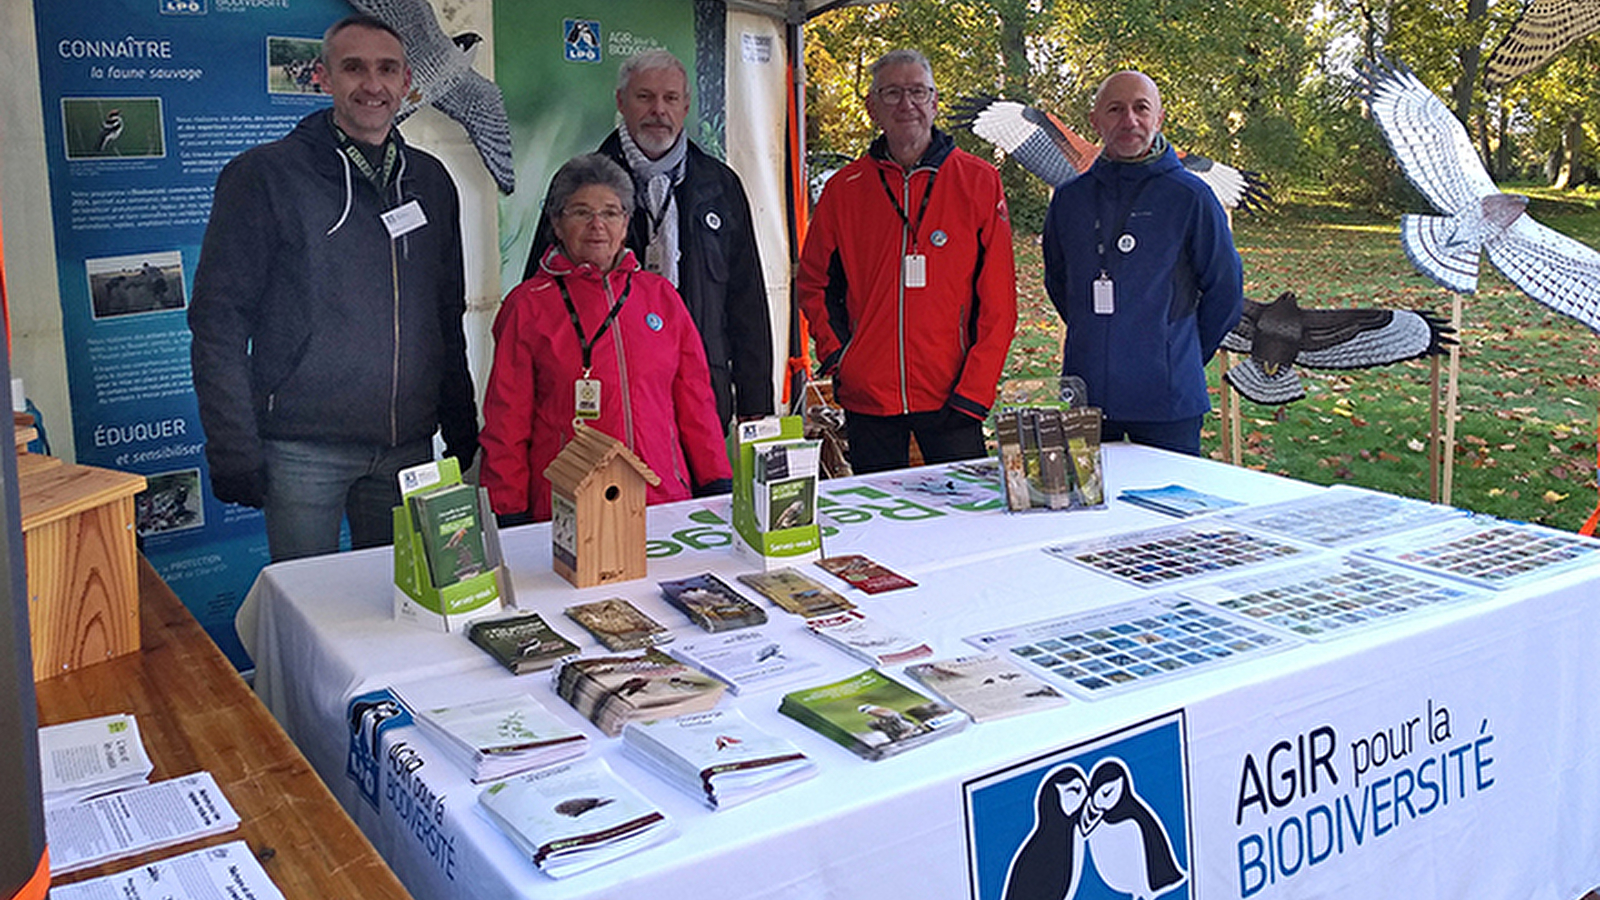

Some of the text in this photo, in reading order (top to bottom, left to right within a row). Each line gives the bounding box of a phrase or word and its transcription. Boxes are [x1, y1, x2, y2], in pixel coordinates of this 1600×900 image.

[167, 1, 200, 12] LPO
[58, 36, 172, 59] CONNAÎTRE
[91, 66, 204, 82] la faune sauvage
[94, 418, 187, 447] ÉDUQUER
[132, 443, 203, 464] sensibiliser
[1235, 697, 1453, 827] AGIR pour la
[1236, 718, 1496, 900] BIODIVERSITÉ
[385, 773, 456, 882] BIODIVERSITÉ
